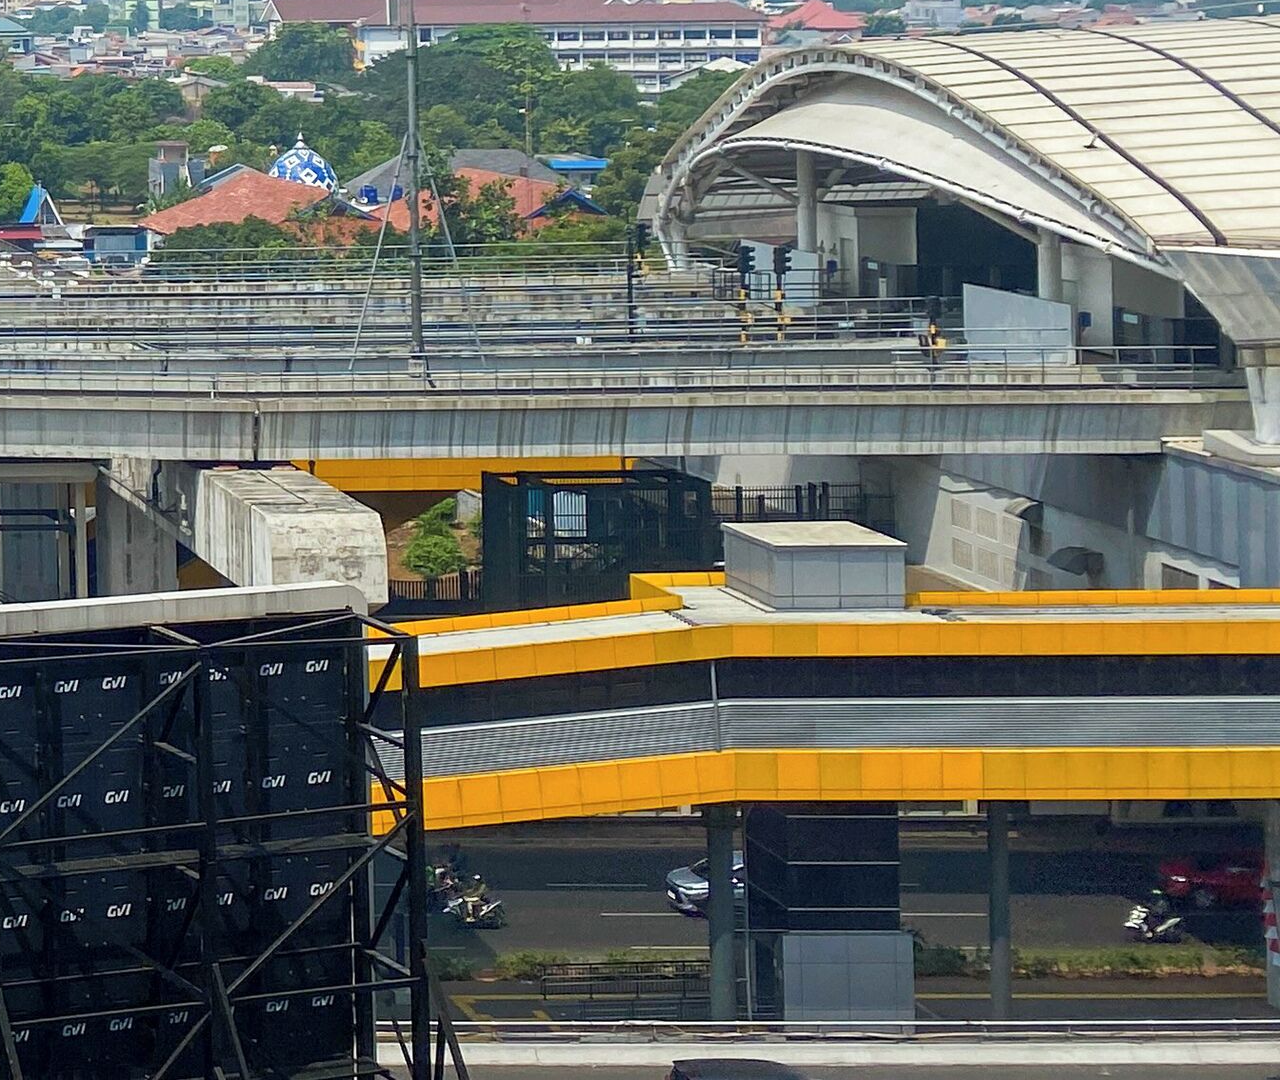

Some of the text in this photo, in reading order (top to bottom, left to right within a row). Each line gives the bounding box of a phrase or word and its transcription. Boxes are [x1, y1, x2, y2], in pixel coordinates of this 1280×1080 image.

[260, 663, 284, 676] GVI
[306, 660, 328, 672] GVI
[54, 680, 78, 693] GVI
[102, 676, 126, 689] GVI
[262, 775, 286, 788] GVI
[308, 770, 332, 784] GVI
[57, 794, 82, 808] GVI
[104, 790, 129, 804] GVI
[0, 800, 25, 814] GVI
[216, 893, 234, 906] VI
[264, 886, 288, 900] GVI
[107, 904, 132, 918] GVI
[3, 914, 28, 929] GVI
[266, 1000, 289, 1013] GVI
[312, 995, 335, 1008] GVI
[62, 1023, 86, 1037] GVI
[110, 1018, 133, 1032] GVI
[11, 1030, 30, 1043] VI
